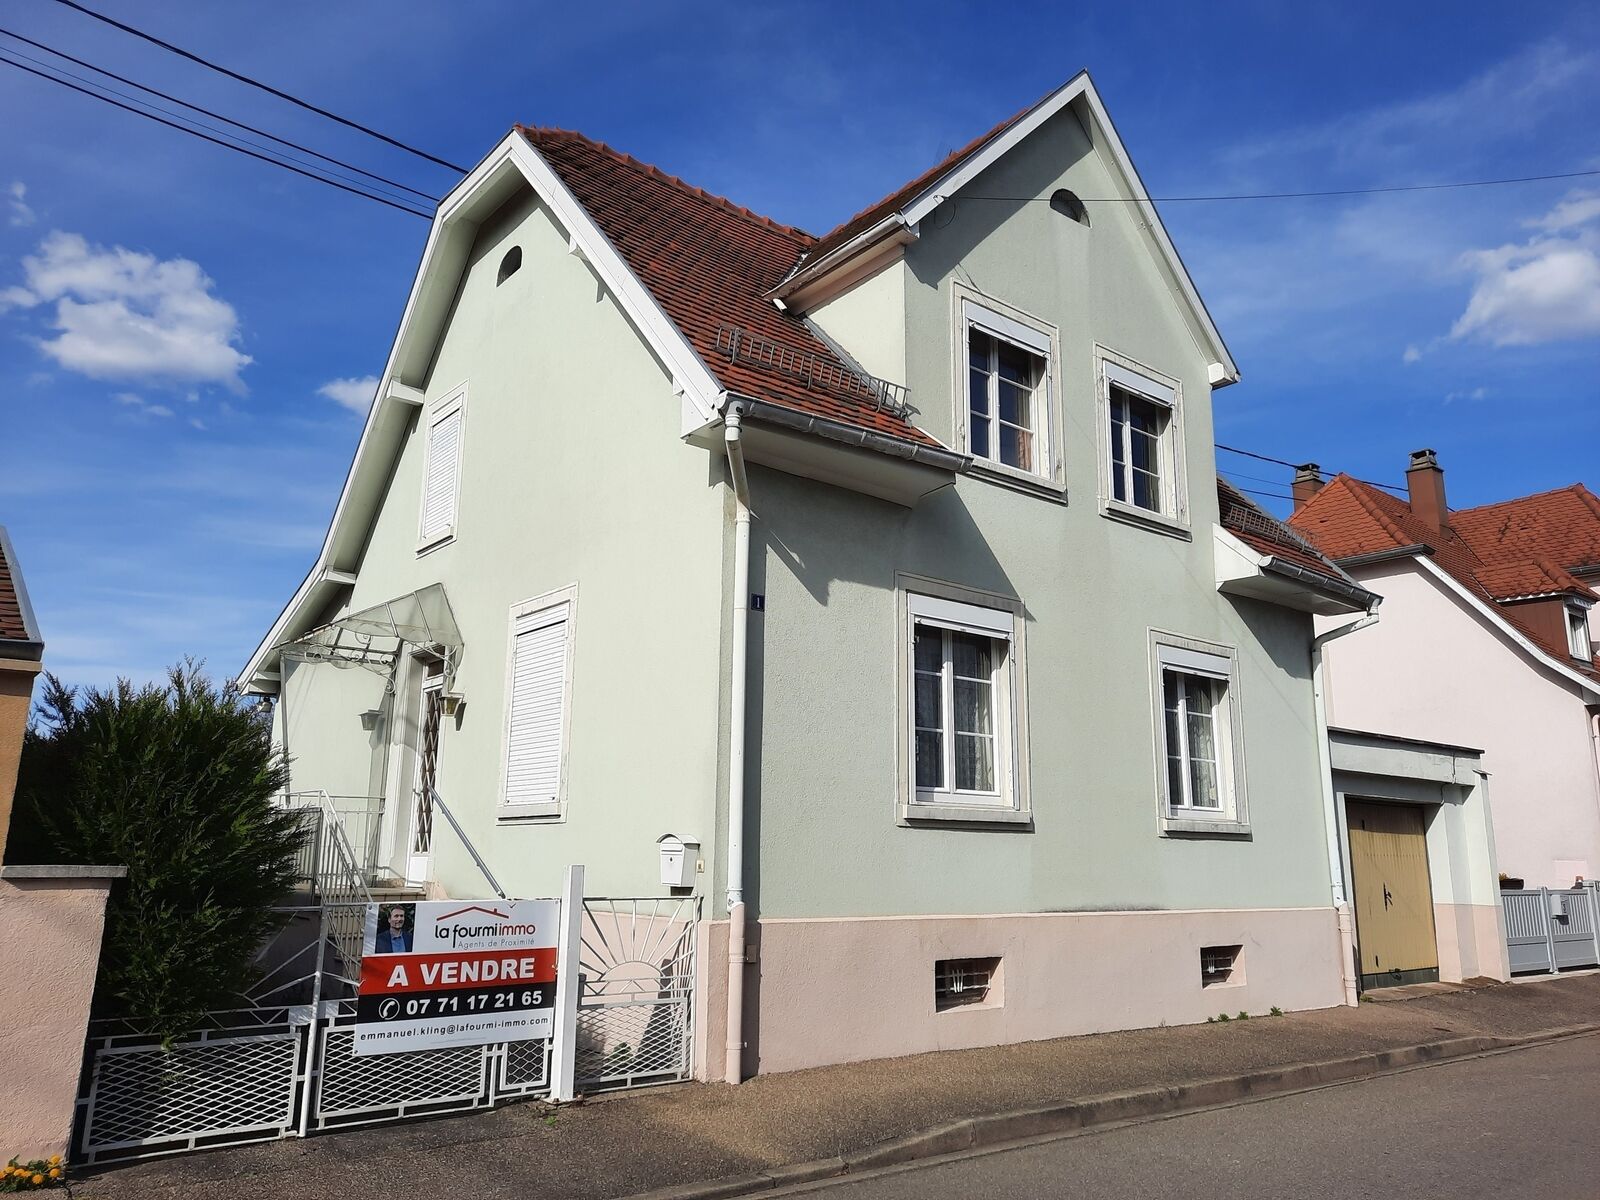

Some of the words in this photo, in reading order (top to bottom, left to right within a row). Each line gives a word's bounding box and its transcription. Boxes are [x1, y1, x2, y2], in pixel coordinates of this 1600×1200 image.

[434, 924, 449, 939] la
[458, 941, 484, 950] Agents
[488, 939, 498, 947] de
[501, 937, 535, 947] Proximité
[387, 964, 409, 988] A
[420, 958, 535, 985] VENDRE
[406, 999, 431, 1015] 07
[437, 996, 458, 1013] 71
[466, 994, 489, 1010] 17
[494, 992, 514, 1008] 21
[521, 990, 542, 1006] 65
[360, 1017, 548, 1041] emmanuel.kling@lafourmi-immo.com
